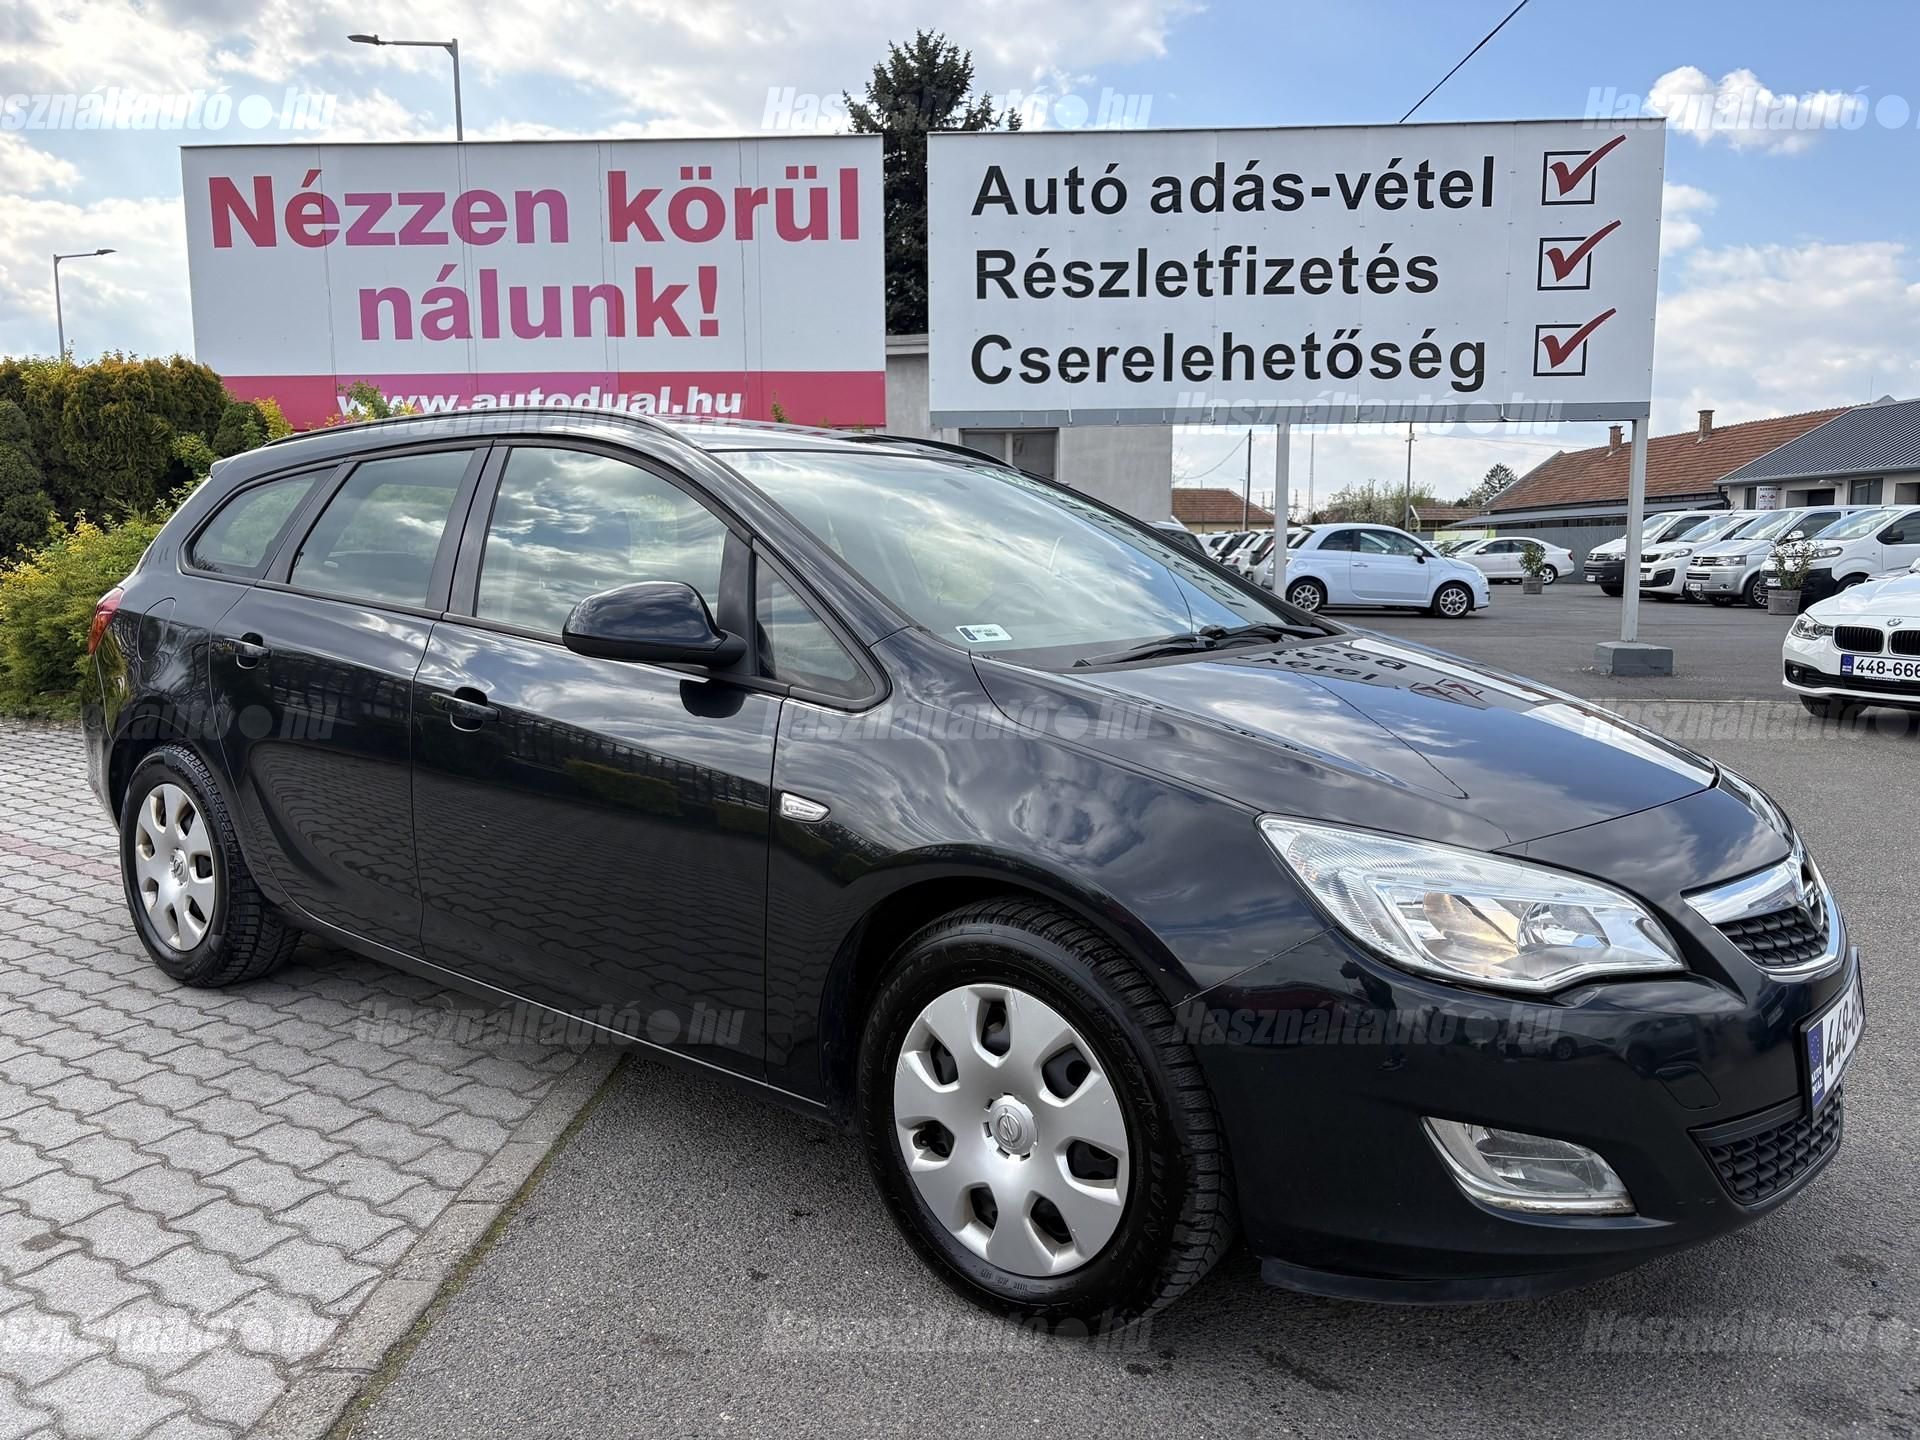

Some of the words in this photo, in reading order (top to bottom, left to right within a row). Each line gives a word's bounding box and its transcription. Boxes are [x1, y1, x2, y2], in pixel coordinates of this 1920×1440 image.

[209, 167, 569, 249] Nézzen
[607, 166, 860, 243] körül
[972, 161, 1128, 216] Autó
[1151, 155, 1494, 214] adás-vétel
[359, 263, 718, 341] nálunk!
[976, 243, 1439, 300] Részletfizetés
[971, 328, 1485, 393] Cserelehetőség
